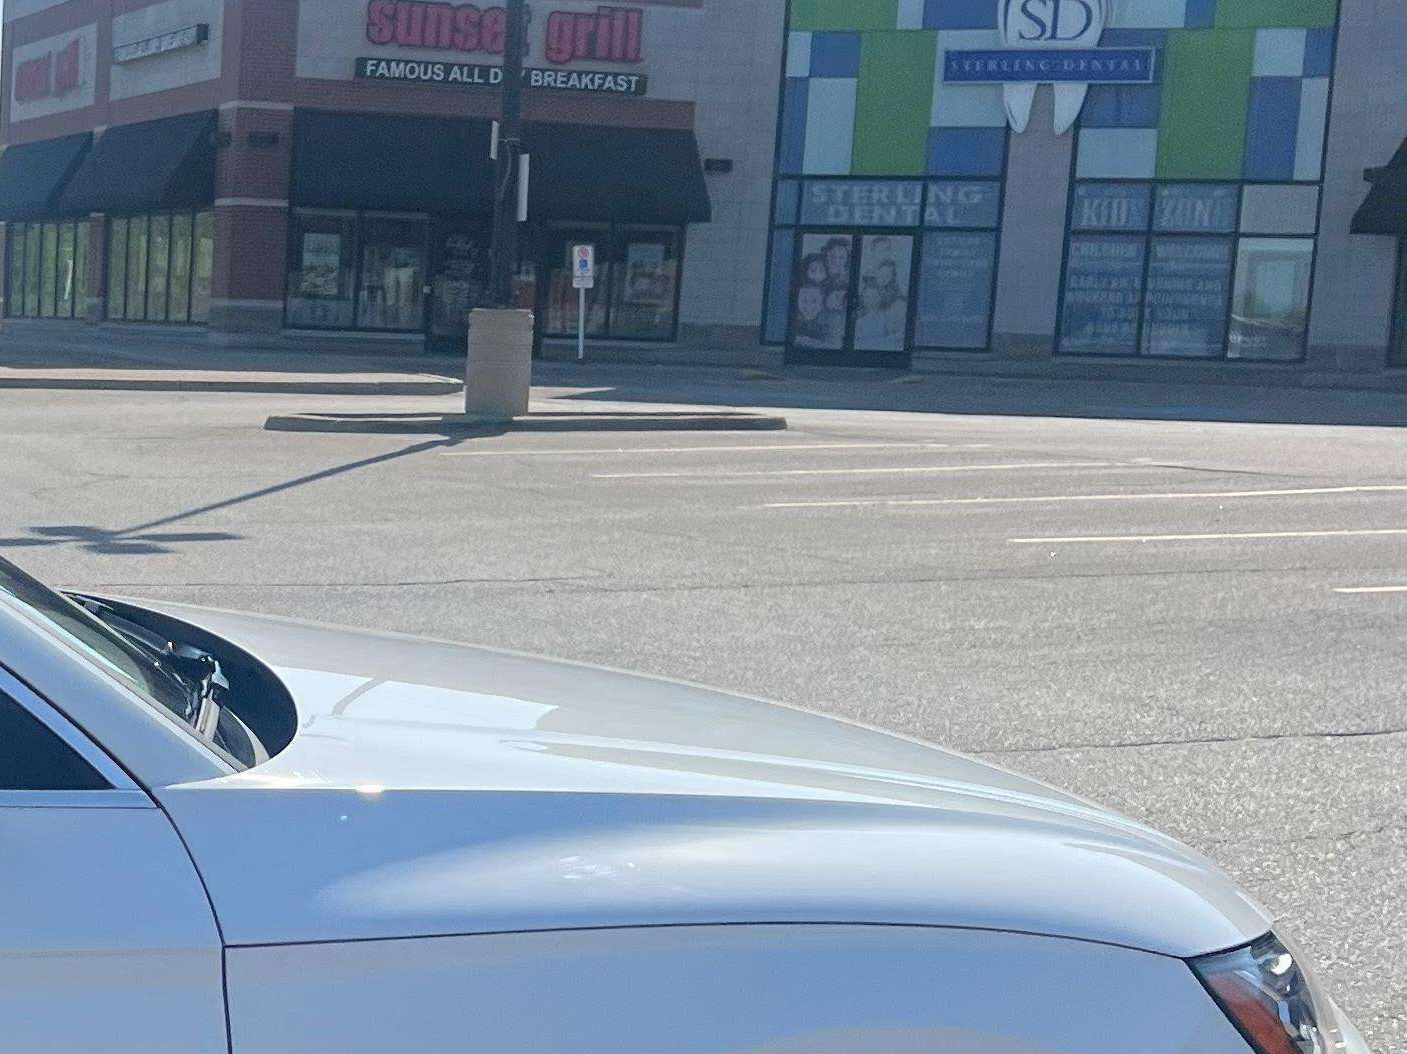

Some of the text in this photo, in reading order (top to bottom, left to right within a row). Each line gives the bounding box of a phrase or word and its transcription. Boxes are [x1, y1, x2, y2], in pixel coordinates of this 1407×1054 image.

[1018, 0, 1093, 41] SD
[545, 6, 643, 64] grill
[365, 59, 444, 81] FAMOUS
[448, 64, 484, 84] ALL
[530, 71, 639, 92] BREAKFAST
[949, 58, 1142, 73] STERLING DENTAL
[810, 184, 983, 204] STERLING
[827, 205, 961, 225] DENTAL
